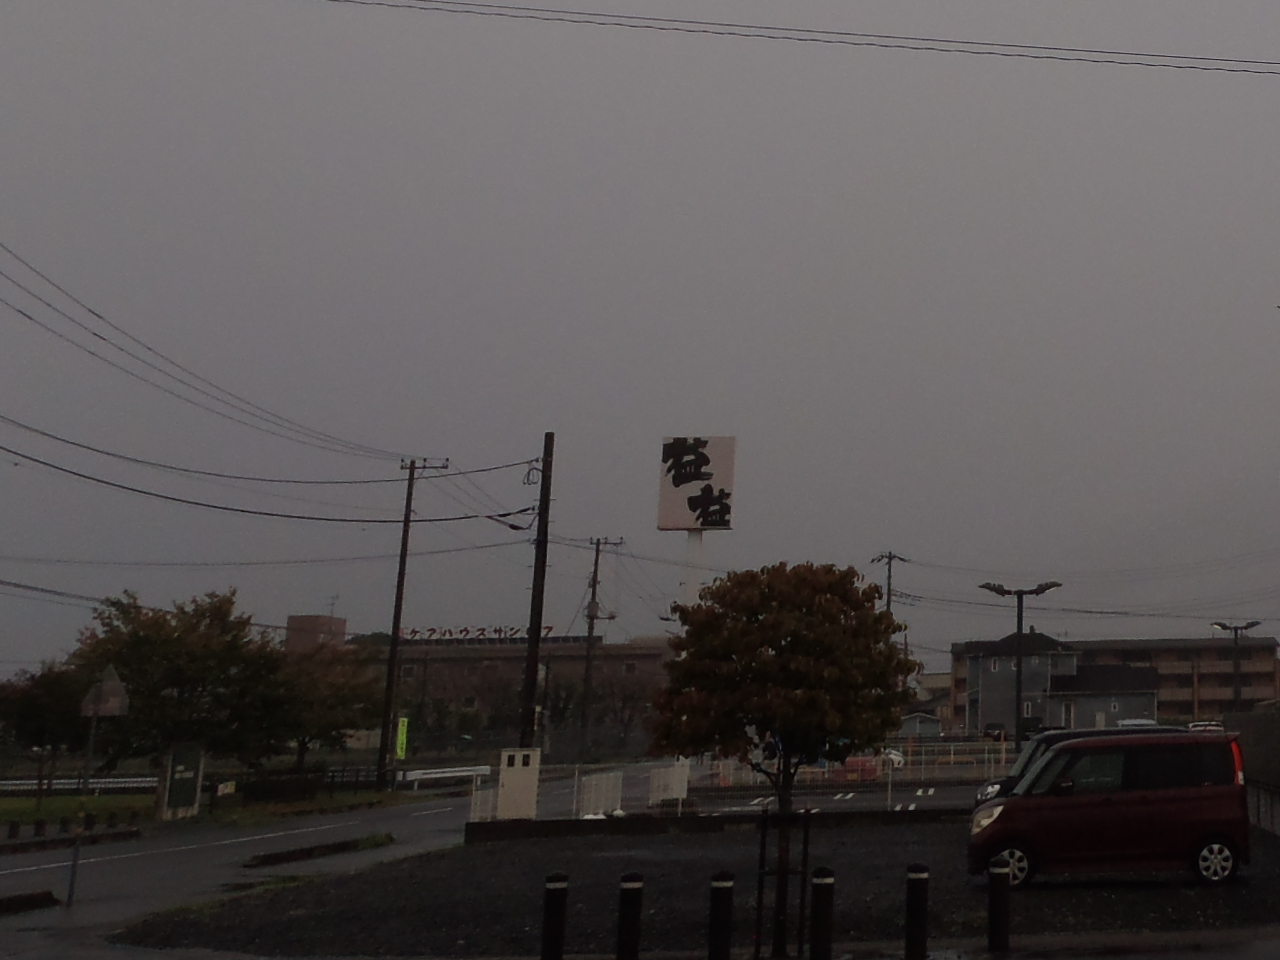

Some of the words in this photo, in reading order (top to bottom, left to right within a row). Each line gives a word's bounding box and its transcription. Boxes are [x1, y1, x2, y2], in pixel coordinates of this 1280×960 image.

[409, 626, 553, 639] ケアハウスサンア
